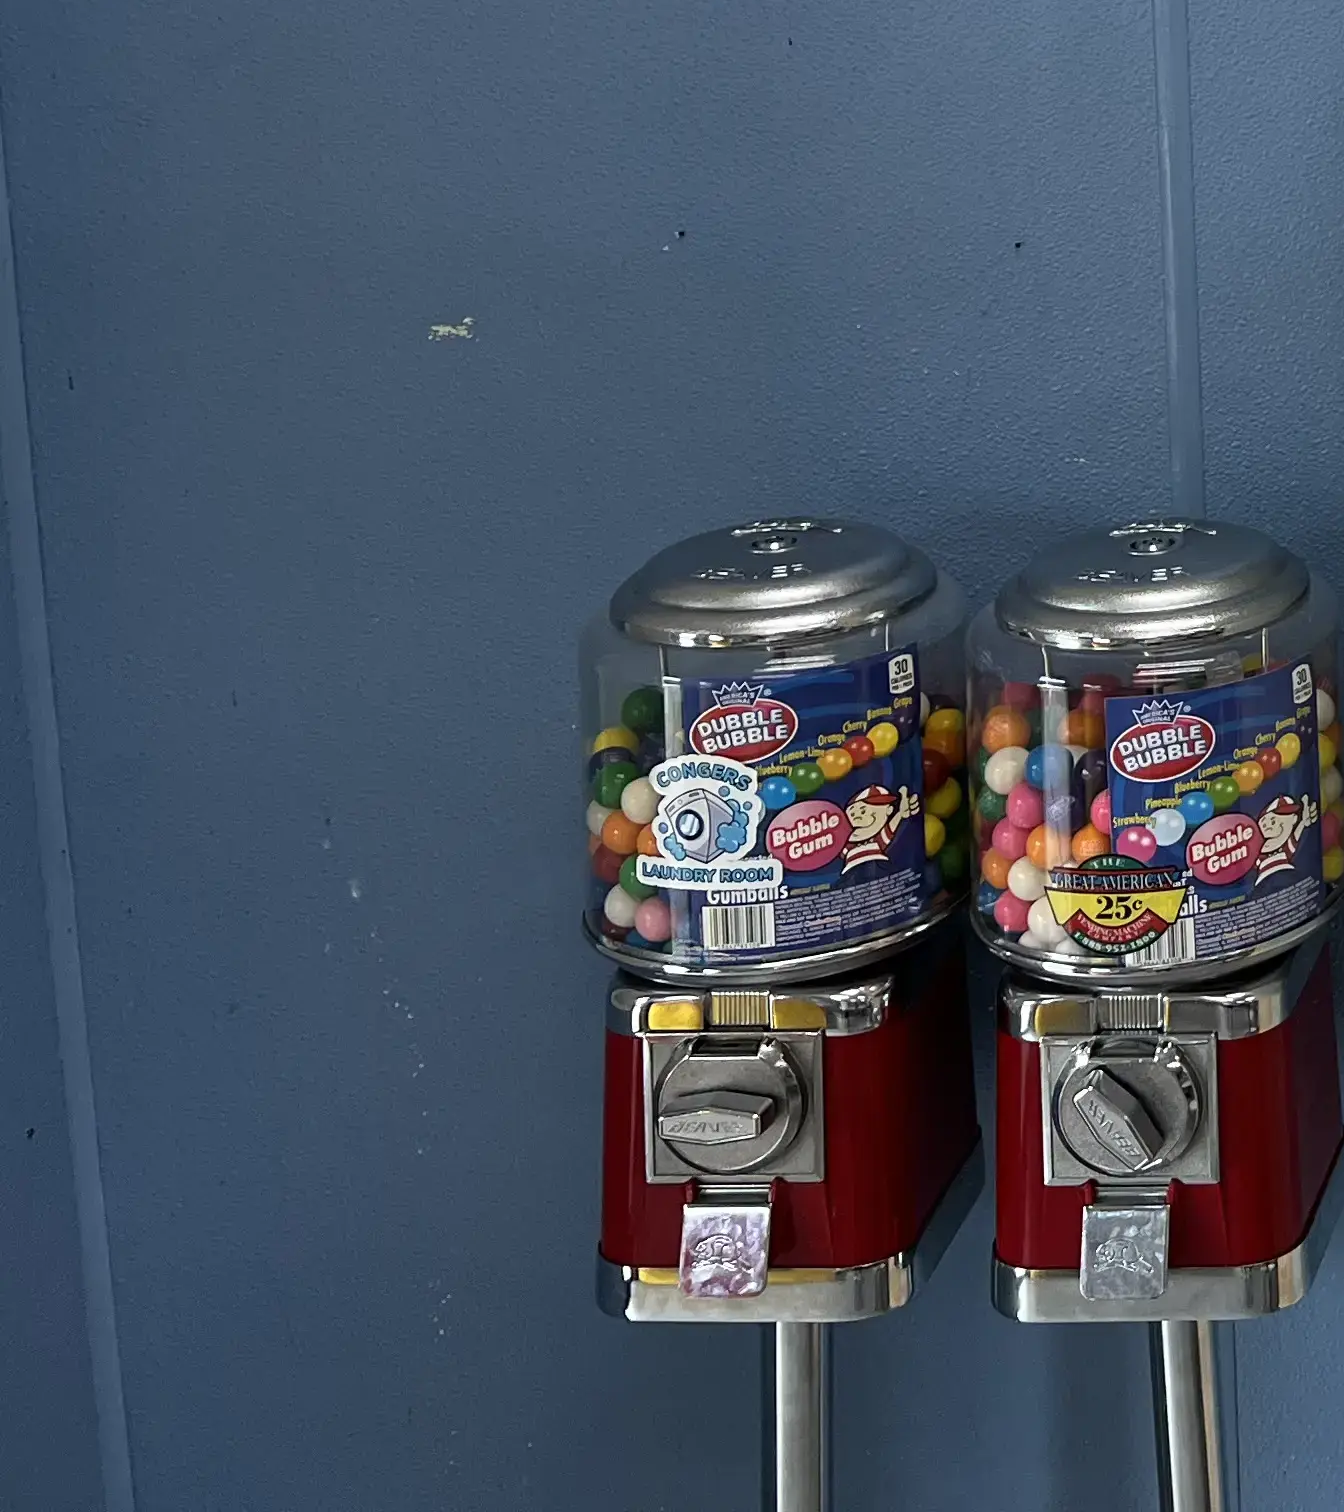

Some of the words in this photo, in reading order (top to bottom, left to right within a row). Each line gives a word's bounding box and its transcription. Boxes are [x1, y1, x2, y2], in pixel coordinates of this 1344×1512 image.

[894, 658, 909, 676] 30
[1296, 668, 1308, 686] 30
[697, 708, 784, 738] DUBBLE
[842, 719, 868, 734] Cherry
[701, 724, 789, 754] BUBBLE
[817, 733, 847, 747] Orange
[1117, 724, 1203, 757] DUBBLE
[1122, 739, 1207, 773] BUBBLE
[656, 761, 753, 792] CONGERS
[1144, 795, 1183, 809] Pineapple
[771, 811, 840, 848] Bubble
[1112, 812, 1157, 829] Strawberry
[788, 833, 834, 860] Gum
[1191, 824, 1254, 862] Bubble
[1089, 857, 1126, 870] THE
[1207, 845, 1248, 873] Gum
[642, 861, 717, 883] LAUNDRY
[719, 867, 774, 883] ROOM
[1054, 873, 1097, 890] GREAT
[1101, 871, 1174, 891] AMERICAN
